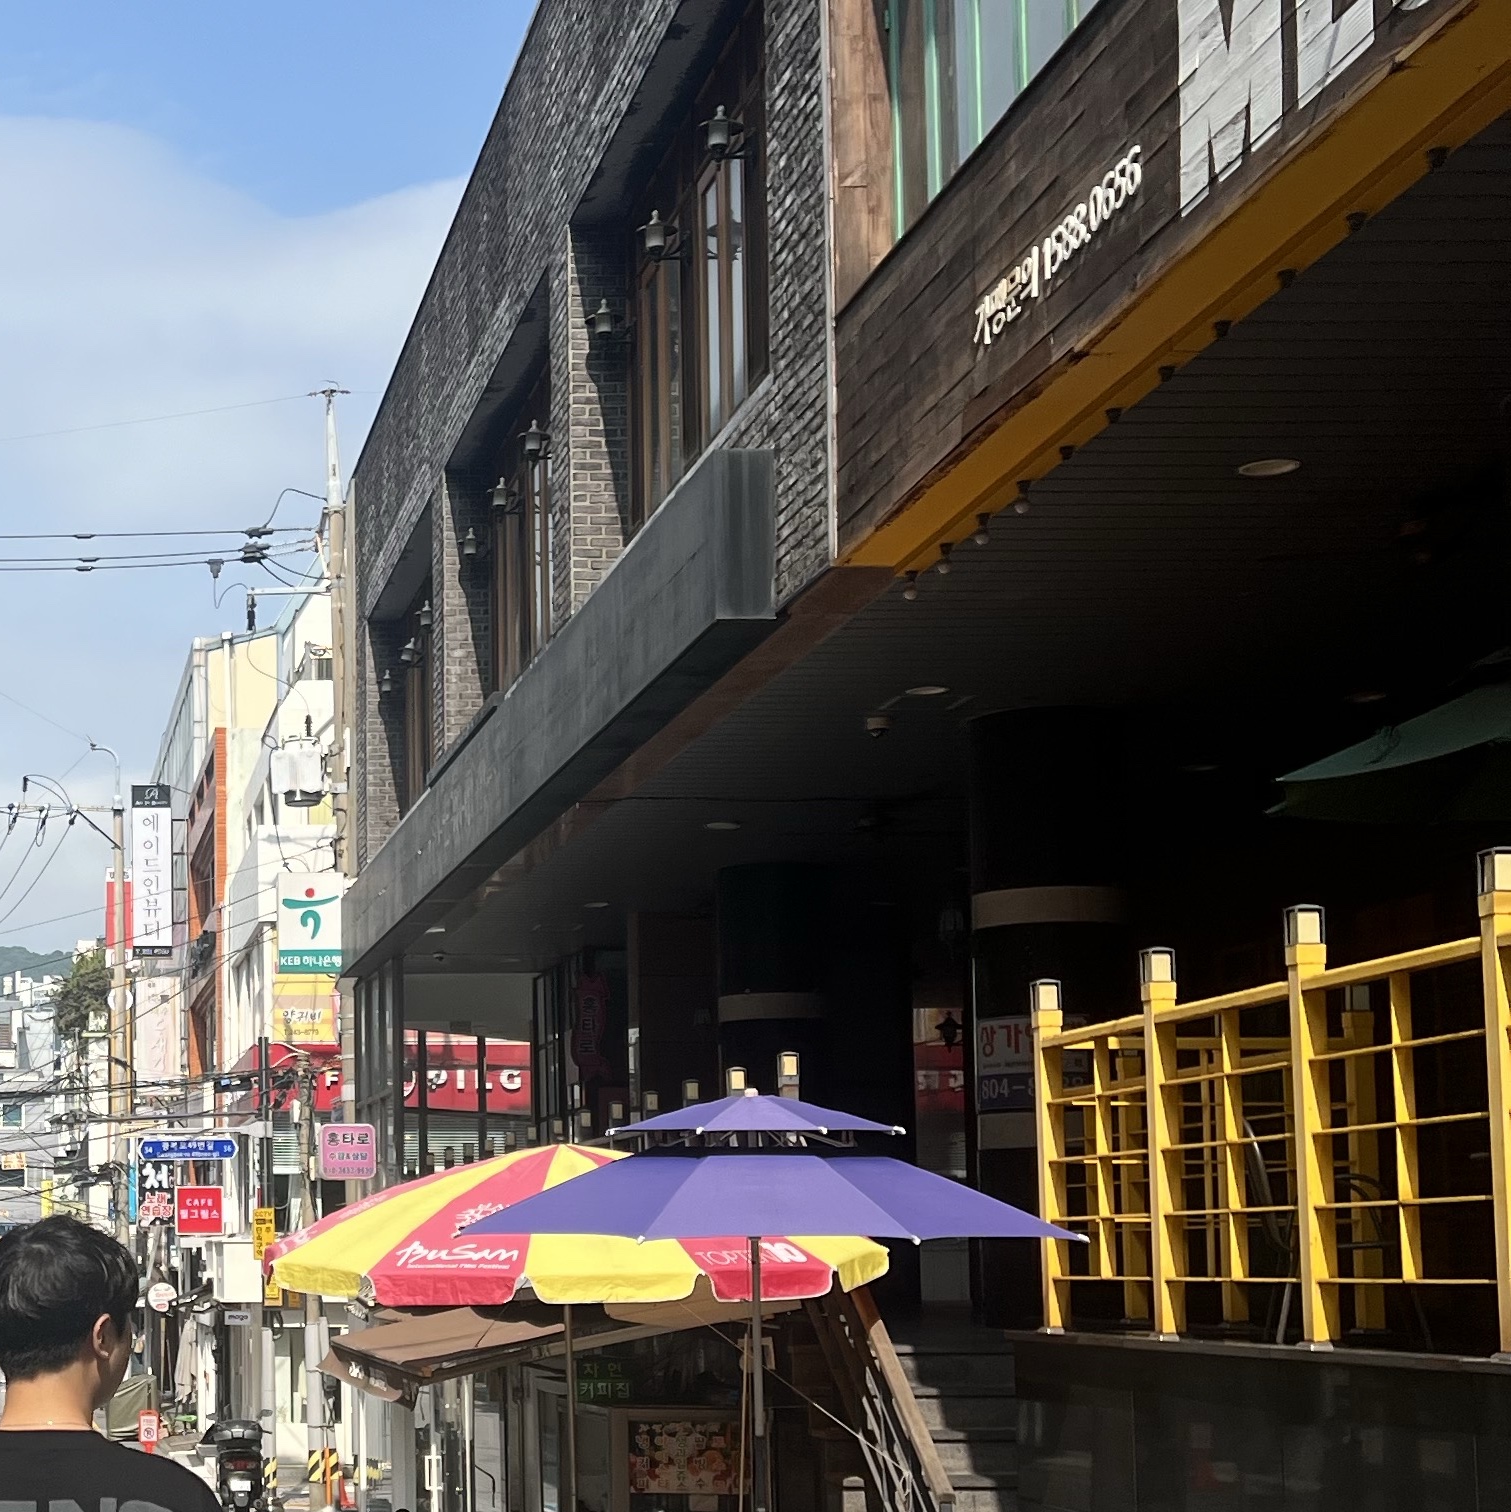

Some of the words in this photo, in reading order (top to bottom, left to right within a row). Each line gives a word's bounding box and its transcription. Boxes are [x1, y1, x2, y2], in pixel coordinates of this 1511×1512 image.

[1042, 144, 1142, 280] 1588.0656
[280, 955, 301, 966] KEB
[326, 1132, 370, 1146] 홍타로
[185, 1198, 213, 1207] CAFE
[579, 1382, 630, 1400] 커피집
